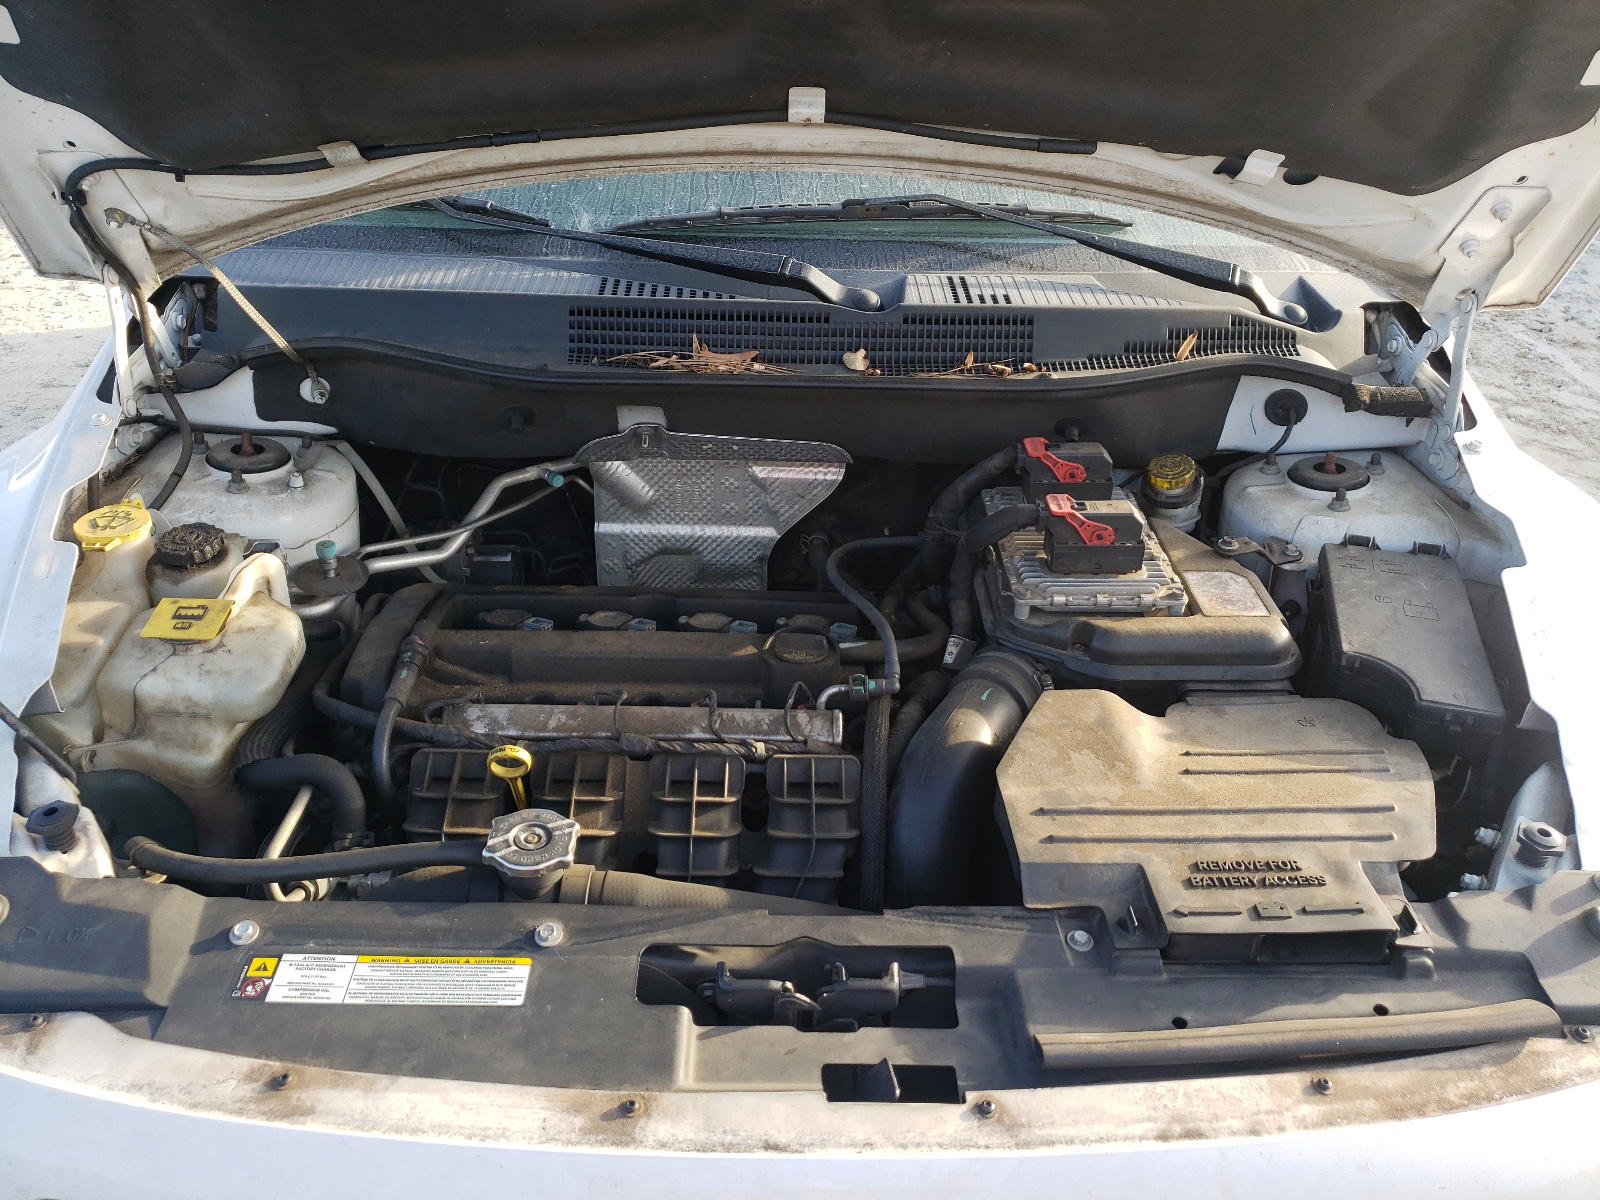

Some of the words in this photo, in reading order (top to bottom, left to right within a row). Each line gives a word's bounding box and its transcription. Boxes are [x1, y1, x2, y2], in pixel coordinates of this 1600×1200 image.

[1197, 859, 1266, 872] REMOVE
[1268, 859, 1303, 871] FOR
[1189, 874, 1259, 887] BATTERY
[1265, 874, 1328, 886] ACCESS
